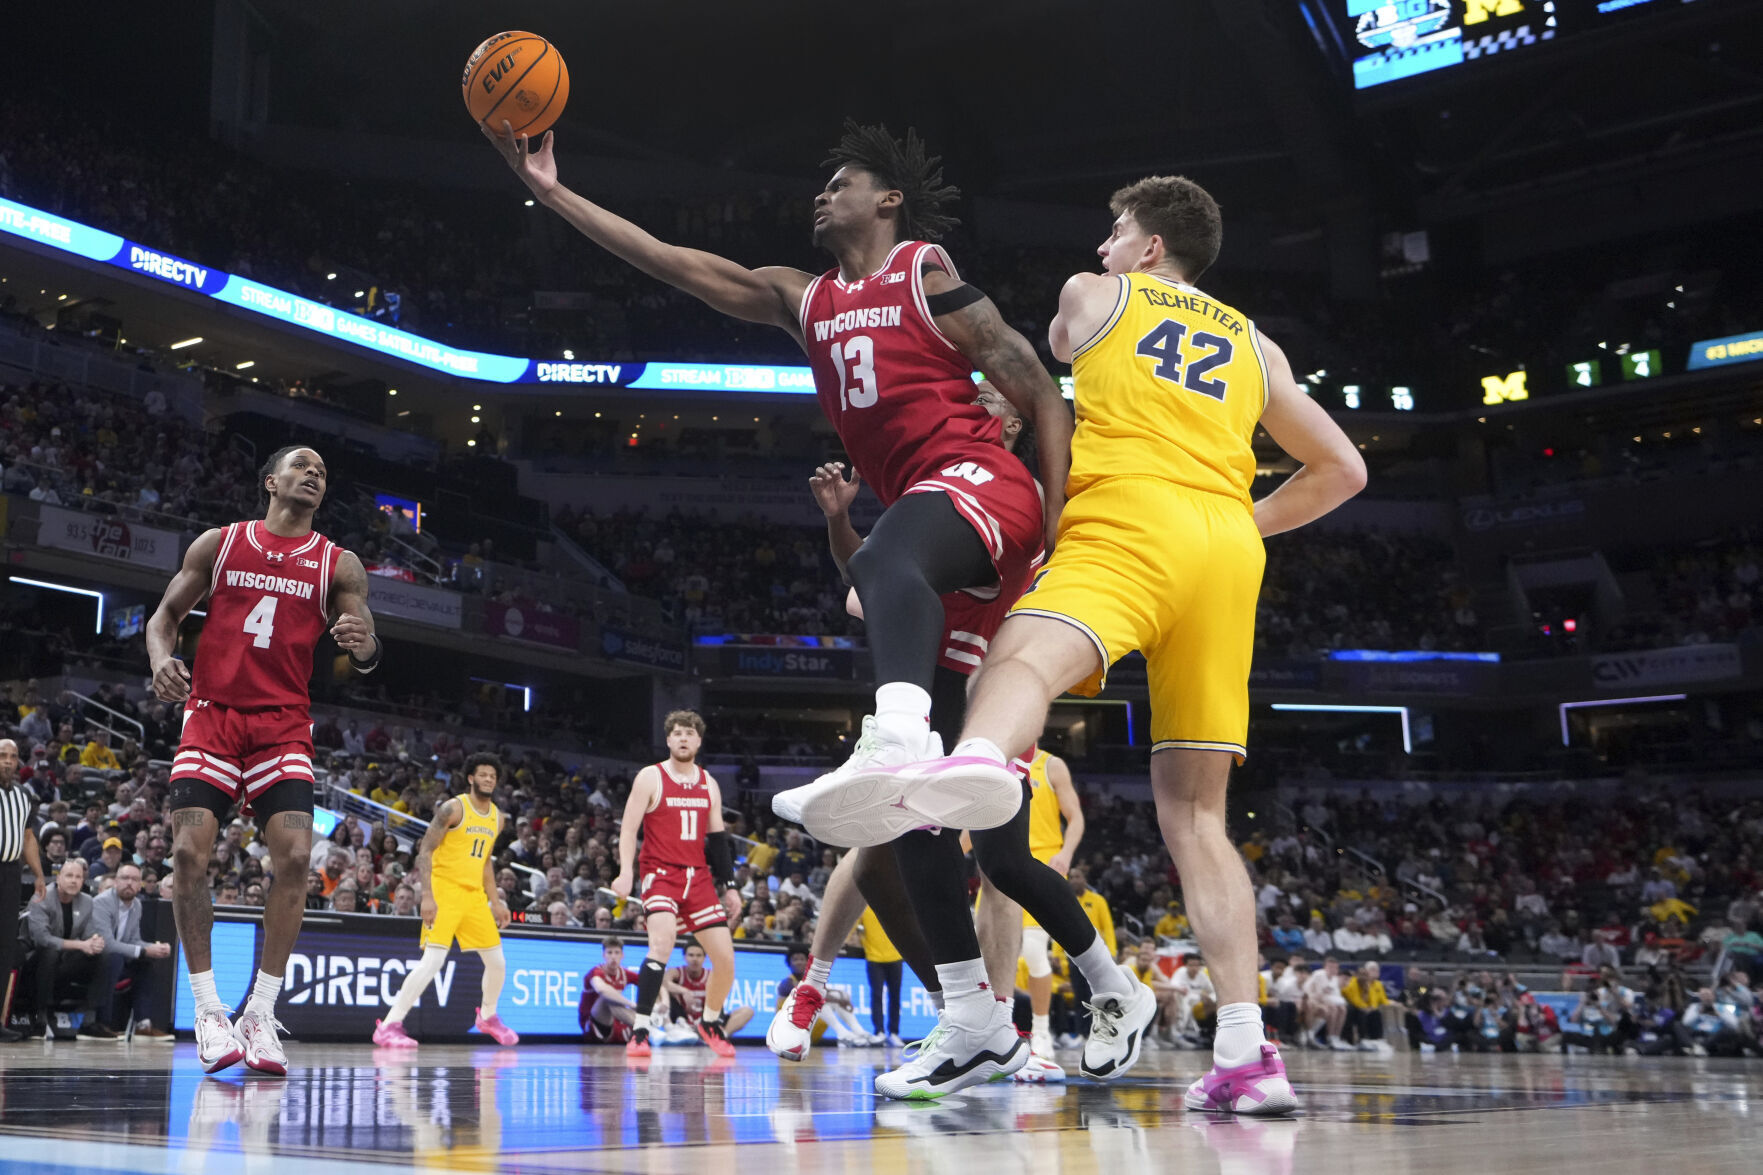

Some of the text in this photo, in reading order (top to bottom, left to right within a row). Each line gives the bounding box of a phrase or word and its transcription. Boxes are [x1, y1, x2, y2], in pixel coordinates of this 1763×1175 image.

[130, 246, 207, 287] DIRECTV
[241, 286, 291, 314] STREAM
[337, 318, 377, 342] GAMES
[1138, 287, 1243, 336] TSCHETTER
[537, 363, 621, 384] DIRECTV
[661, 369, 721, 384] STREAM
[830, 335, 879, 412] 13
[1135, 317, 1234, 403] 42
[226, 570, 315, 600] WISCONSIN
[243, 595, 279, 649] 4
[680, 810, 698, 841] 11
[470, 838, 486, 859] 11
